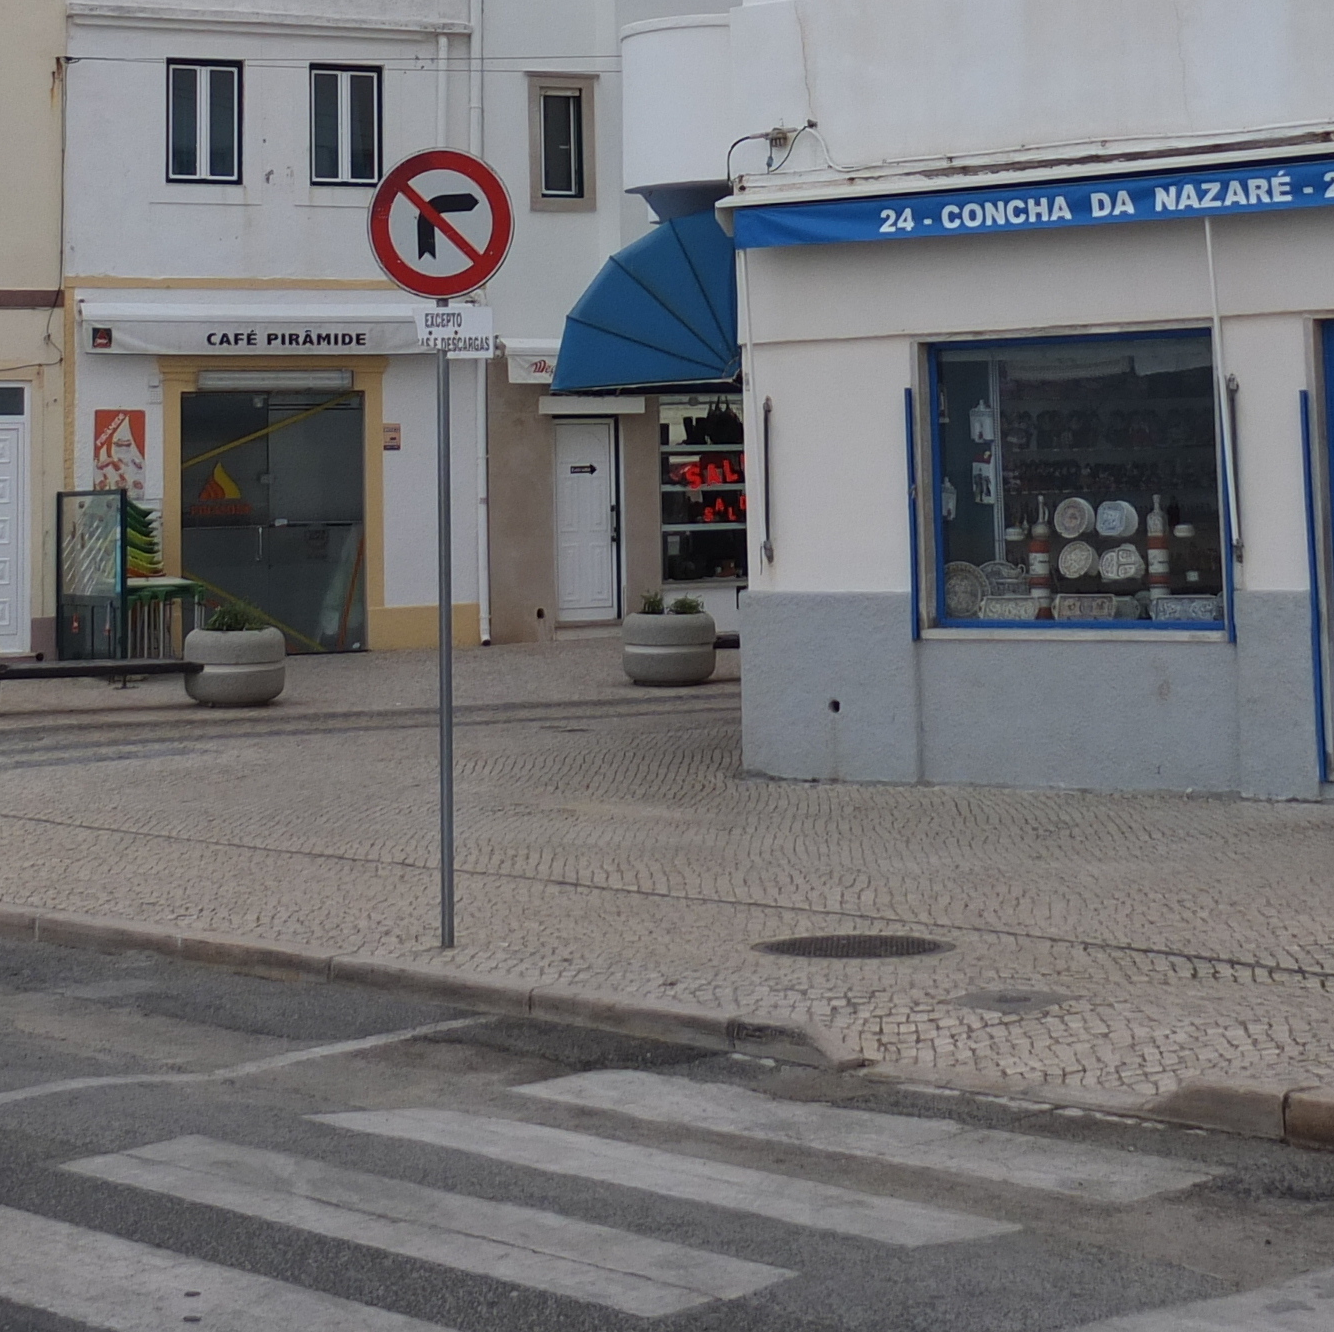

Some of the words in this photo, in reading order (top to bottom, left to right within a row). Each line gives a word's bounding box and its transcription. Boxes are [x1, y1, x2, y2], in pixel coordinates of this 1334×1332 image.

[879, 207, 915, 233] 24
[941, 195, 1073, 229] CONCHA
[1091, 190, 1135, 218] DA
[1154, 170, 1293, 212] NAZARÉ
[424, 312, 463, 328] EXCEPTO
[206, 329, 258, 346] CAFÉ
[266, 329, 367, 346] PIRÂMIDE
[441, 335, 490, 352] DESCARGAS
